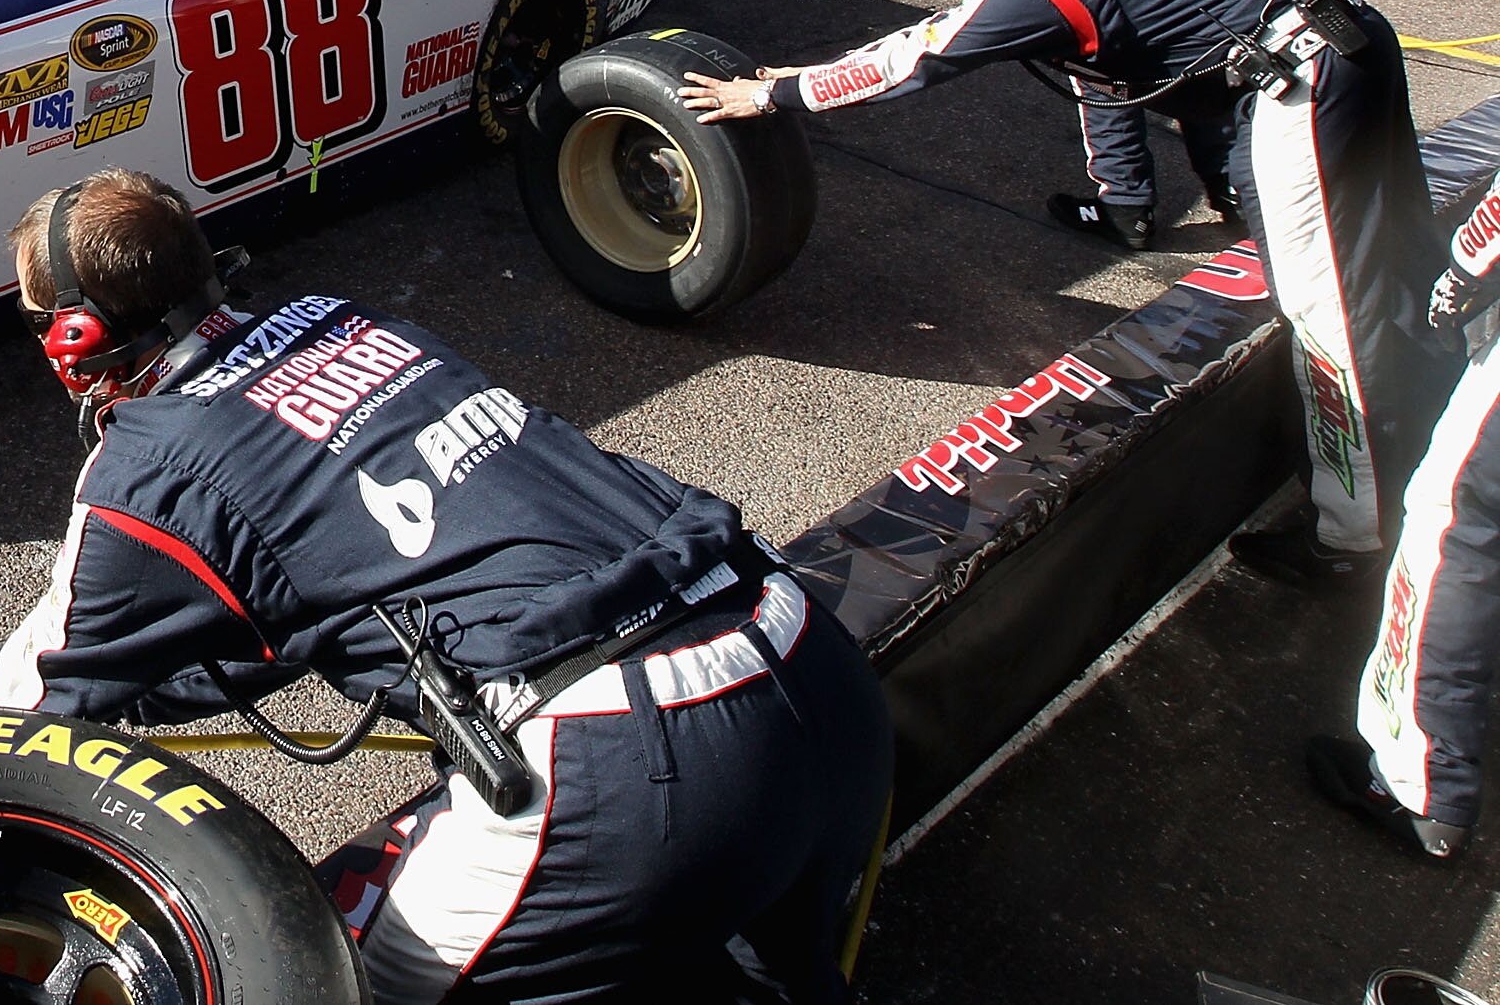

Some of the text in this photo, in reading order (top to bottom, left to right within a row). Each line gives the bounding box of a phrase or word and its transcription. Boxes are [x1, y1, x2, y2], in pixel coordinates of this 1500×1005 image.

[94, 23, 123, 44] NASCAR
[100, 36, 130, 57] Sprint
[405, 26, 463, 62] NATIONAL
[119, 73, 150, 92] LIGHT
[402, 39, 478, 99] GUARD
[808, 57, 858, 82] NATIONAL
[811, 63, 883, 103] GUARD
[41, 77, 68, 97] WEAR
[97, 88, 141, 108] POLE
[33, 90, 75, 130] USG
[75, 95, 152, 149] JEGS
[28, 133, 72, 154] SHEETROCK
[245, 330, 351, 412] NATIONAL
[274, 327, 425, 443] GUARD
[327, 358, 445, 456] NATIONALGUARD.com
[451, 434, 507, 485] ENERGY
[619, 616, 650, 639] ENERGY
[486, 739, 505, 762] HMS
[100, 794, 147, 831] LF 12
[74, 894, 119, 928] AERO
